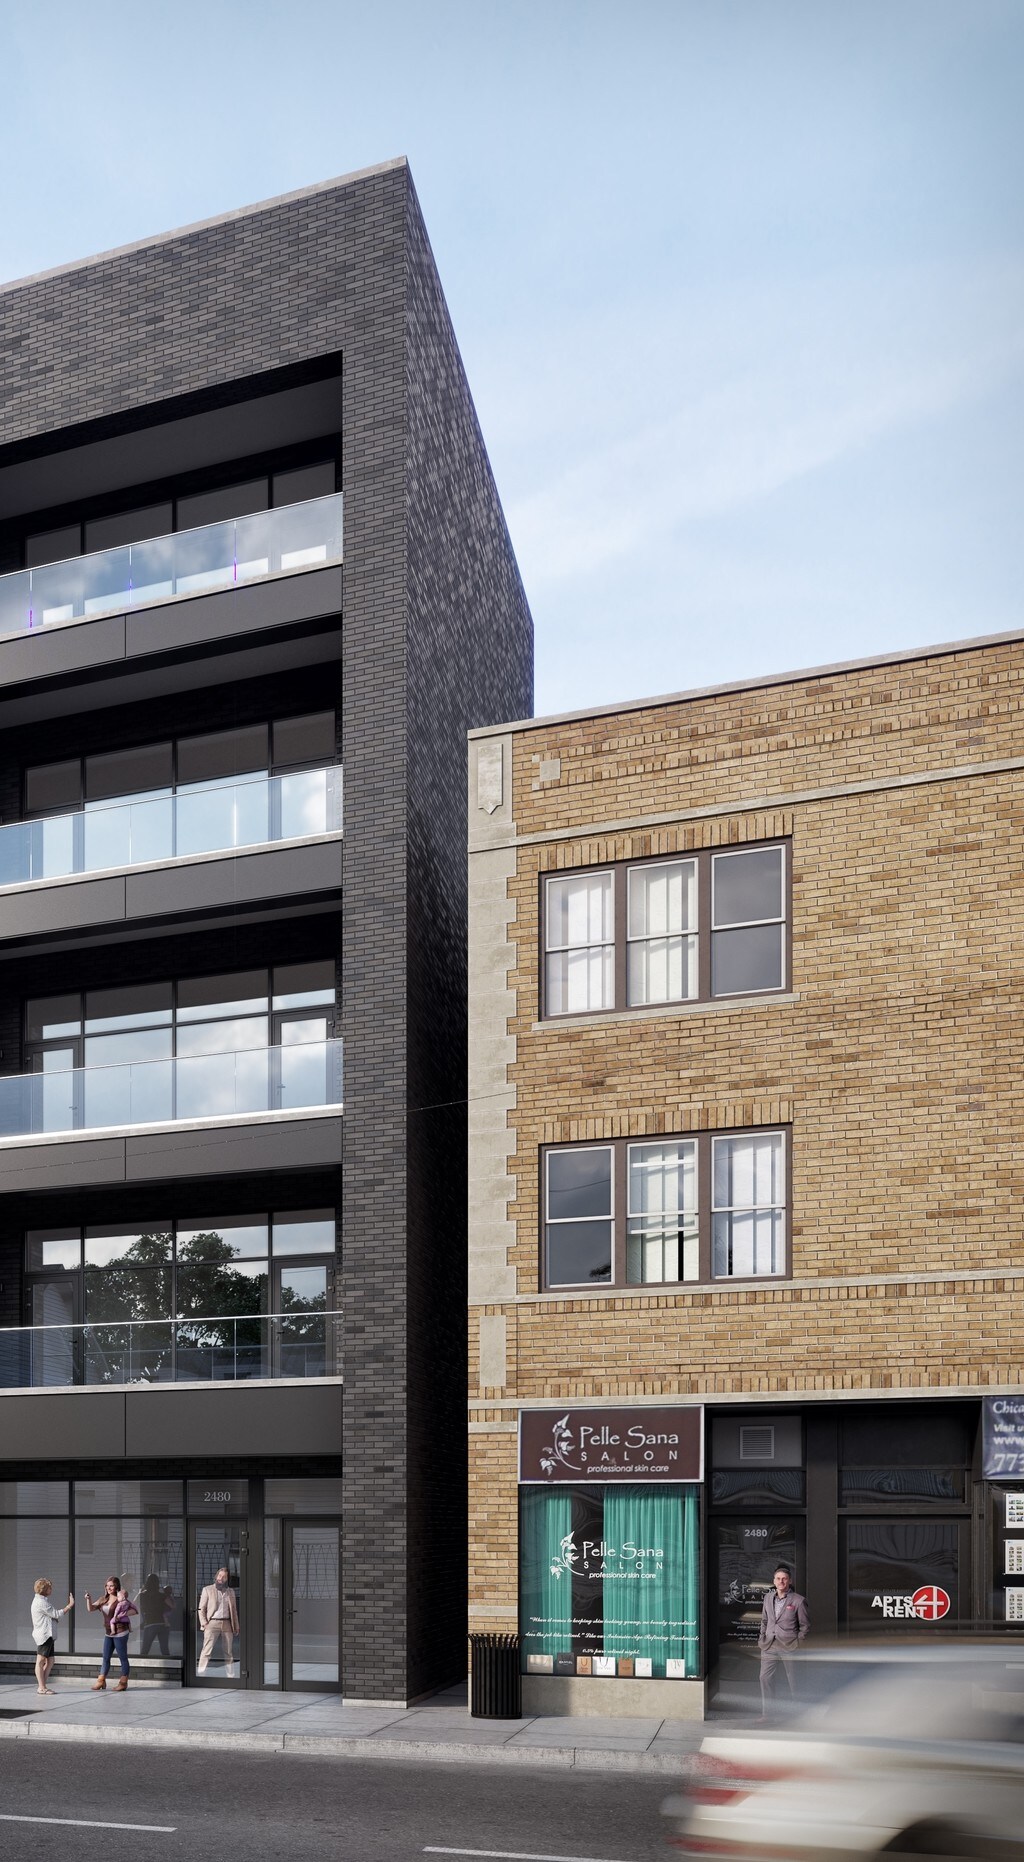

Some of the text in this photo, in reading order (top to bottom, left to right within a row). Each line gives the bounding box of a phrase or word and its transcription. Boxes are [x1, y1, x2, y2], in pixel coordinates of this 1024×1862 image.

[993, 1424, 1015, 1432] Visit
[580, 1425, 679, 1448] Pelle Sana
[580, 1450, 678, 1461] SALON
[587, 1464, 633, 1474] professional
[634, 1464, 649, 1472] skin
[204, 1491, 231, 1502] 2480
[744, 1529, 768, 1537] 2480
[582, 1541, 664, 1560] Pelle Sana
[583, 1561, 663, 1570] SALON
[588, 1571, 627, 1579] professional
[871, 1595, 913, 1608] APTS
[883, 1605, 927, 1618] RENT
